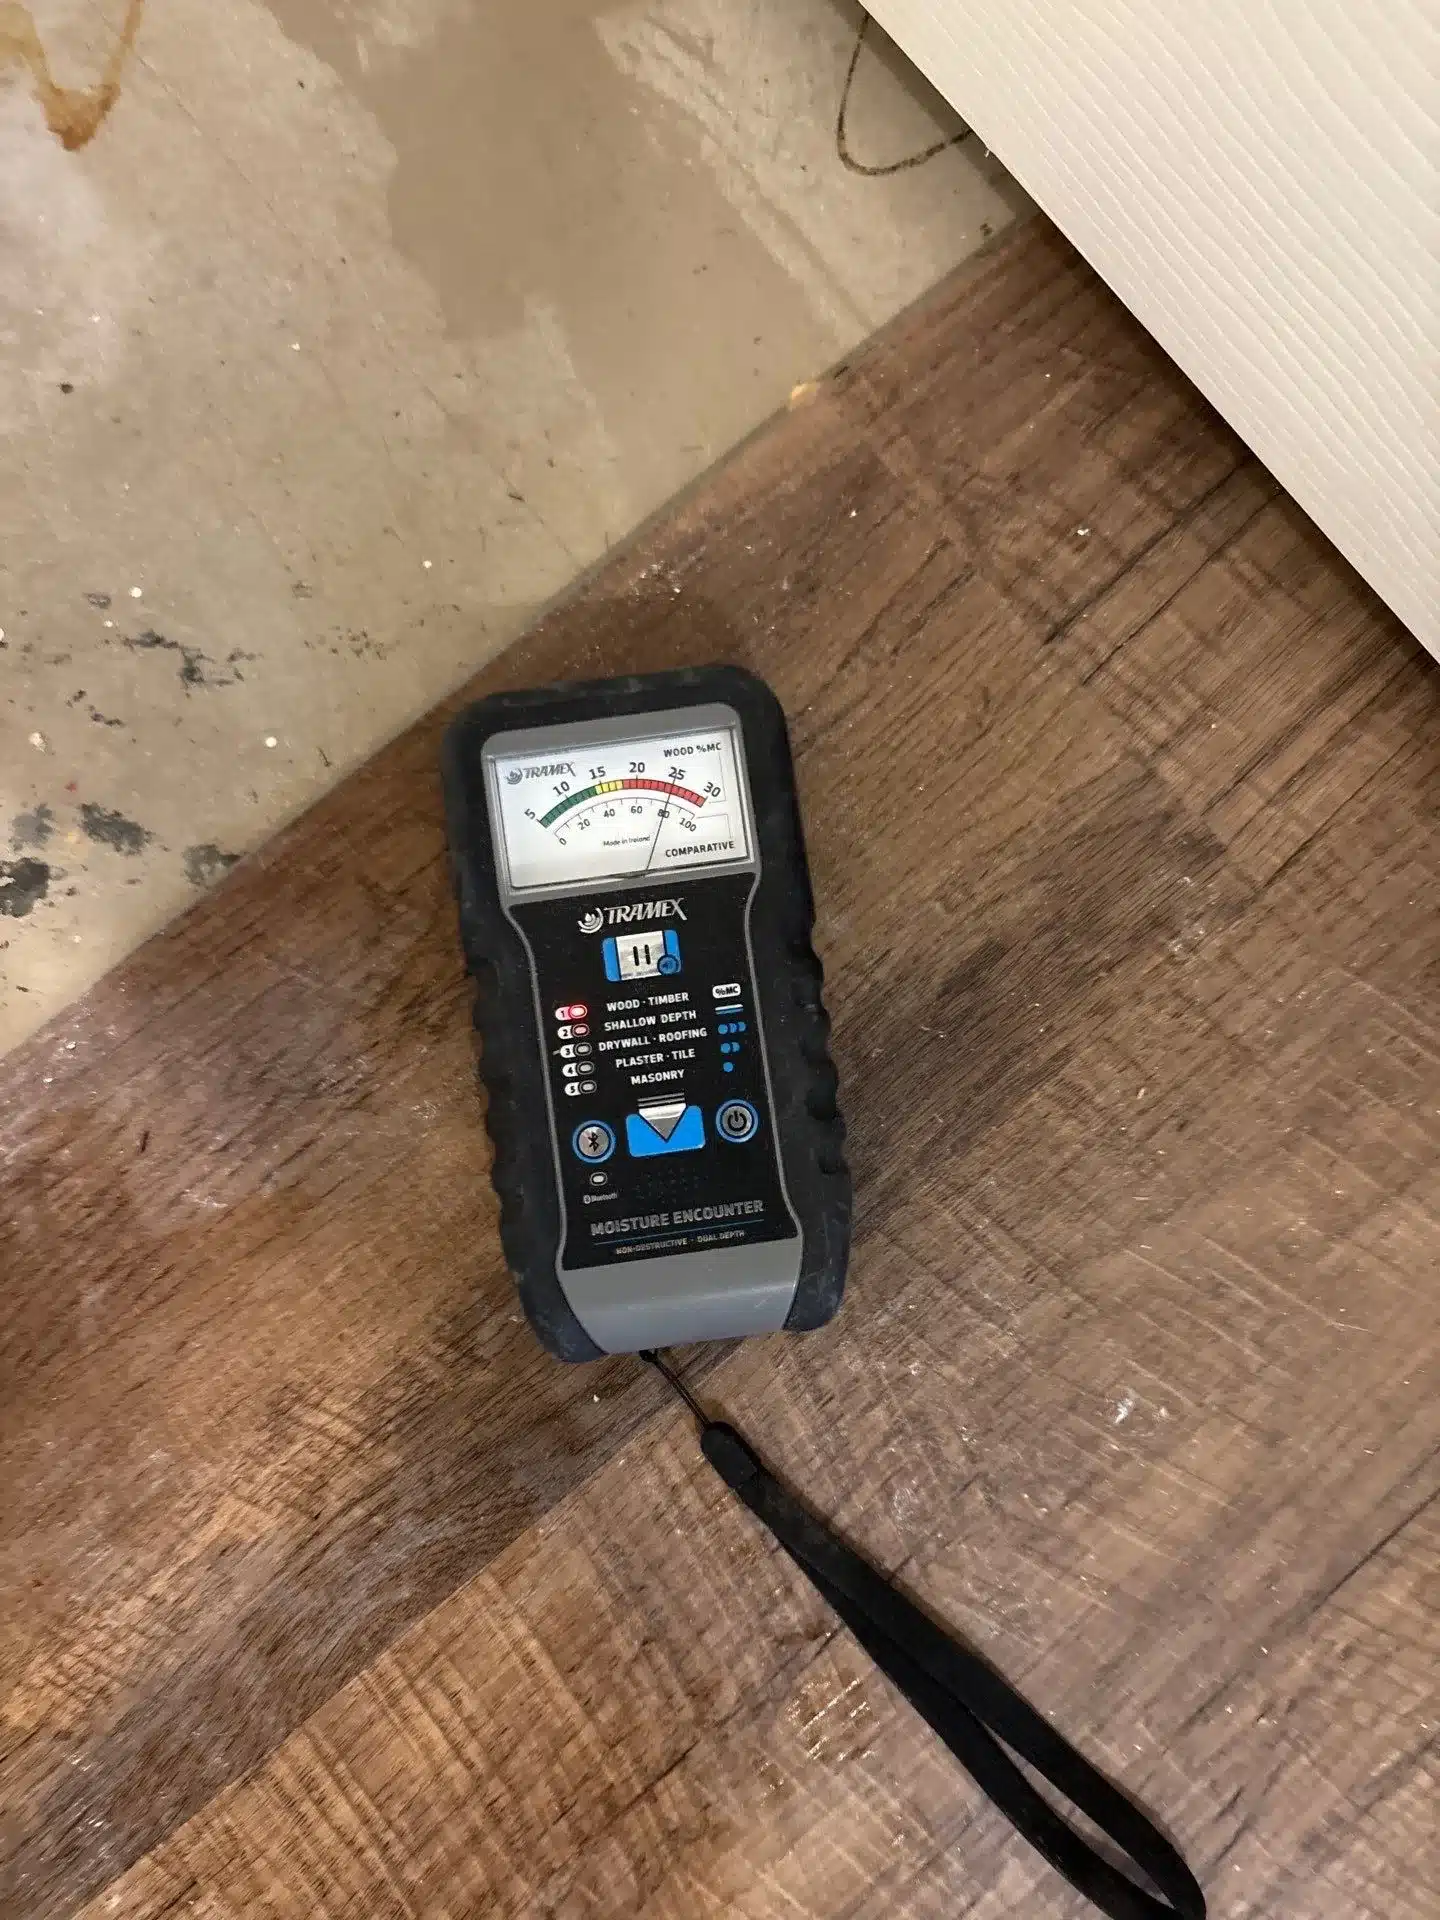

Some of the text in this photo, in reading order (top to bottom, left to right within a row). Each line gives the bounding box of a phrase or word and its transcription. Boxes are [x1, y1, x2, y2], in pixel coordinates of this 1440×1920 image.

[664, 742, 721, 758] WOOD %MC
[522, 761, 577, 778] TRAMEX
[589, 766, 606, 780] 15
[629, 762, 645, 773] 20
[668, 766, 686, 780] 25
[552, 780, 570, 796] 10
[703, 781, 721, 798] 30
[524, 808, 536, 820] 5
[603, 808, 616, 818] 40
[630, 805, 643, 814] 60
[657, 809, 670, 819] 80
[578, 818, 591, 831] 20
[679, 817, 697, 833] 100
[560, 837, 567, 846] 0
[603, 839, 620, 847] Made
[665, 840, 735, 858] COMPARATIVE
[603, 898, 687, 925] TRAMEX
[715, 985, 738, 995] %MC
[607, 992, 689, 1012] WOOD TIMBER
[604, 1010, 697, 1031] SHALLOW DEPTH
[599, 1028, 707, 1051] DRYWALL ROOFING
[564, 1048, 571, 1056] 3
[616, 1049, 695, 1068] PLASTER TILE
[567, 1067, 573, 1075] 4
[630, 1069, 685, 1085] MASONRY
[569, 1085, 576, 1093] 5
[591, 1200, 764, 1236] MOISTURE ENCOUNTER
[616, 1230, 745, 1255] NON-DESTRUCTIVE DUAL DEPTH
